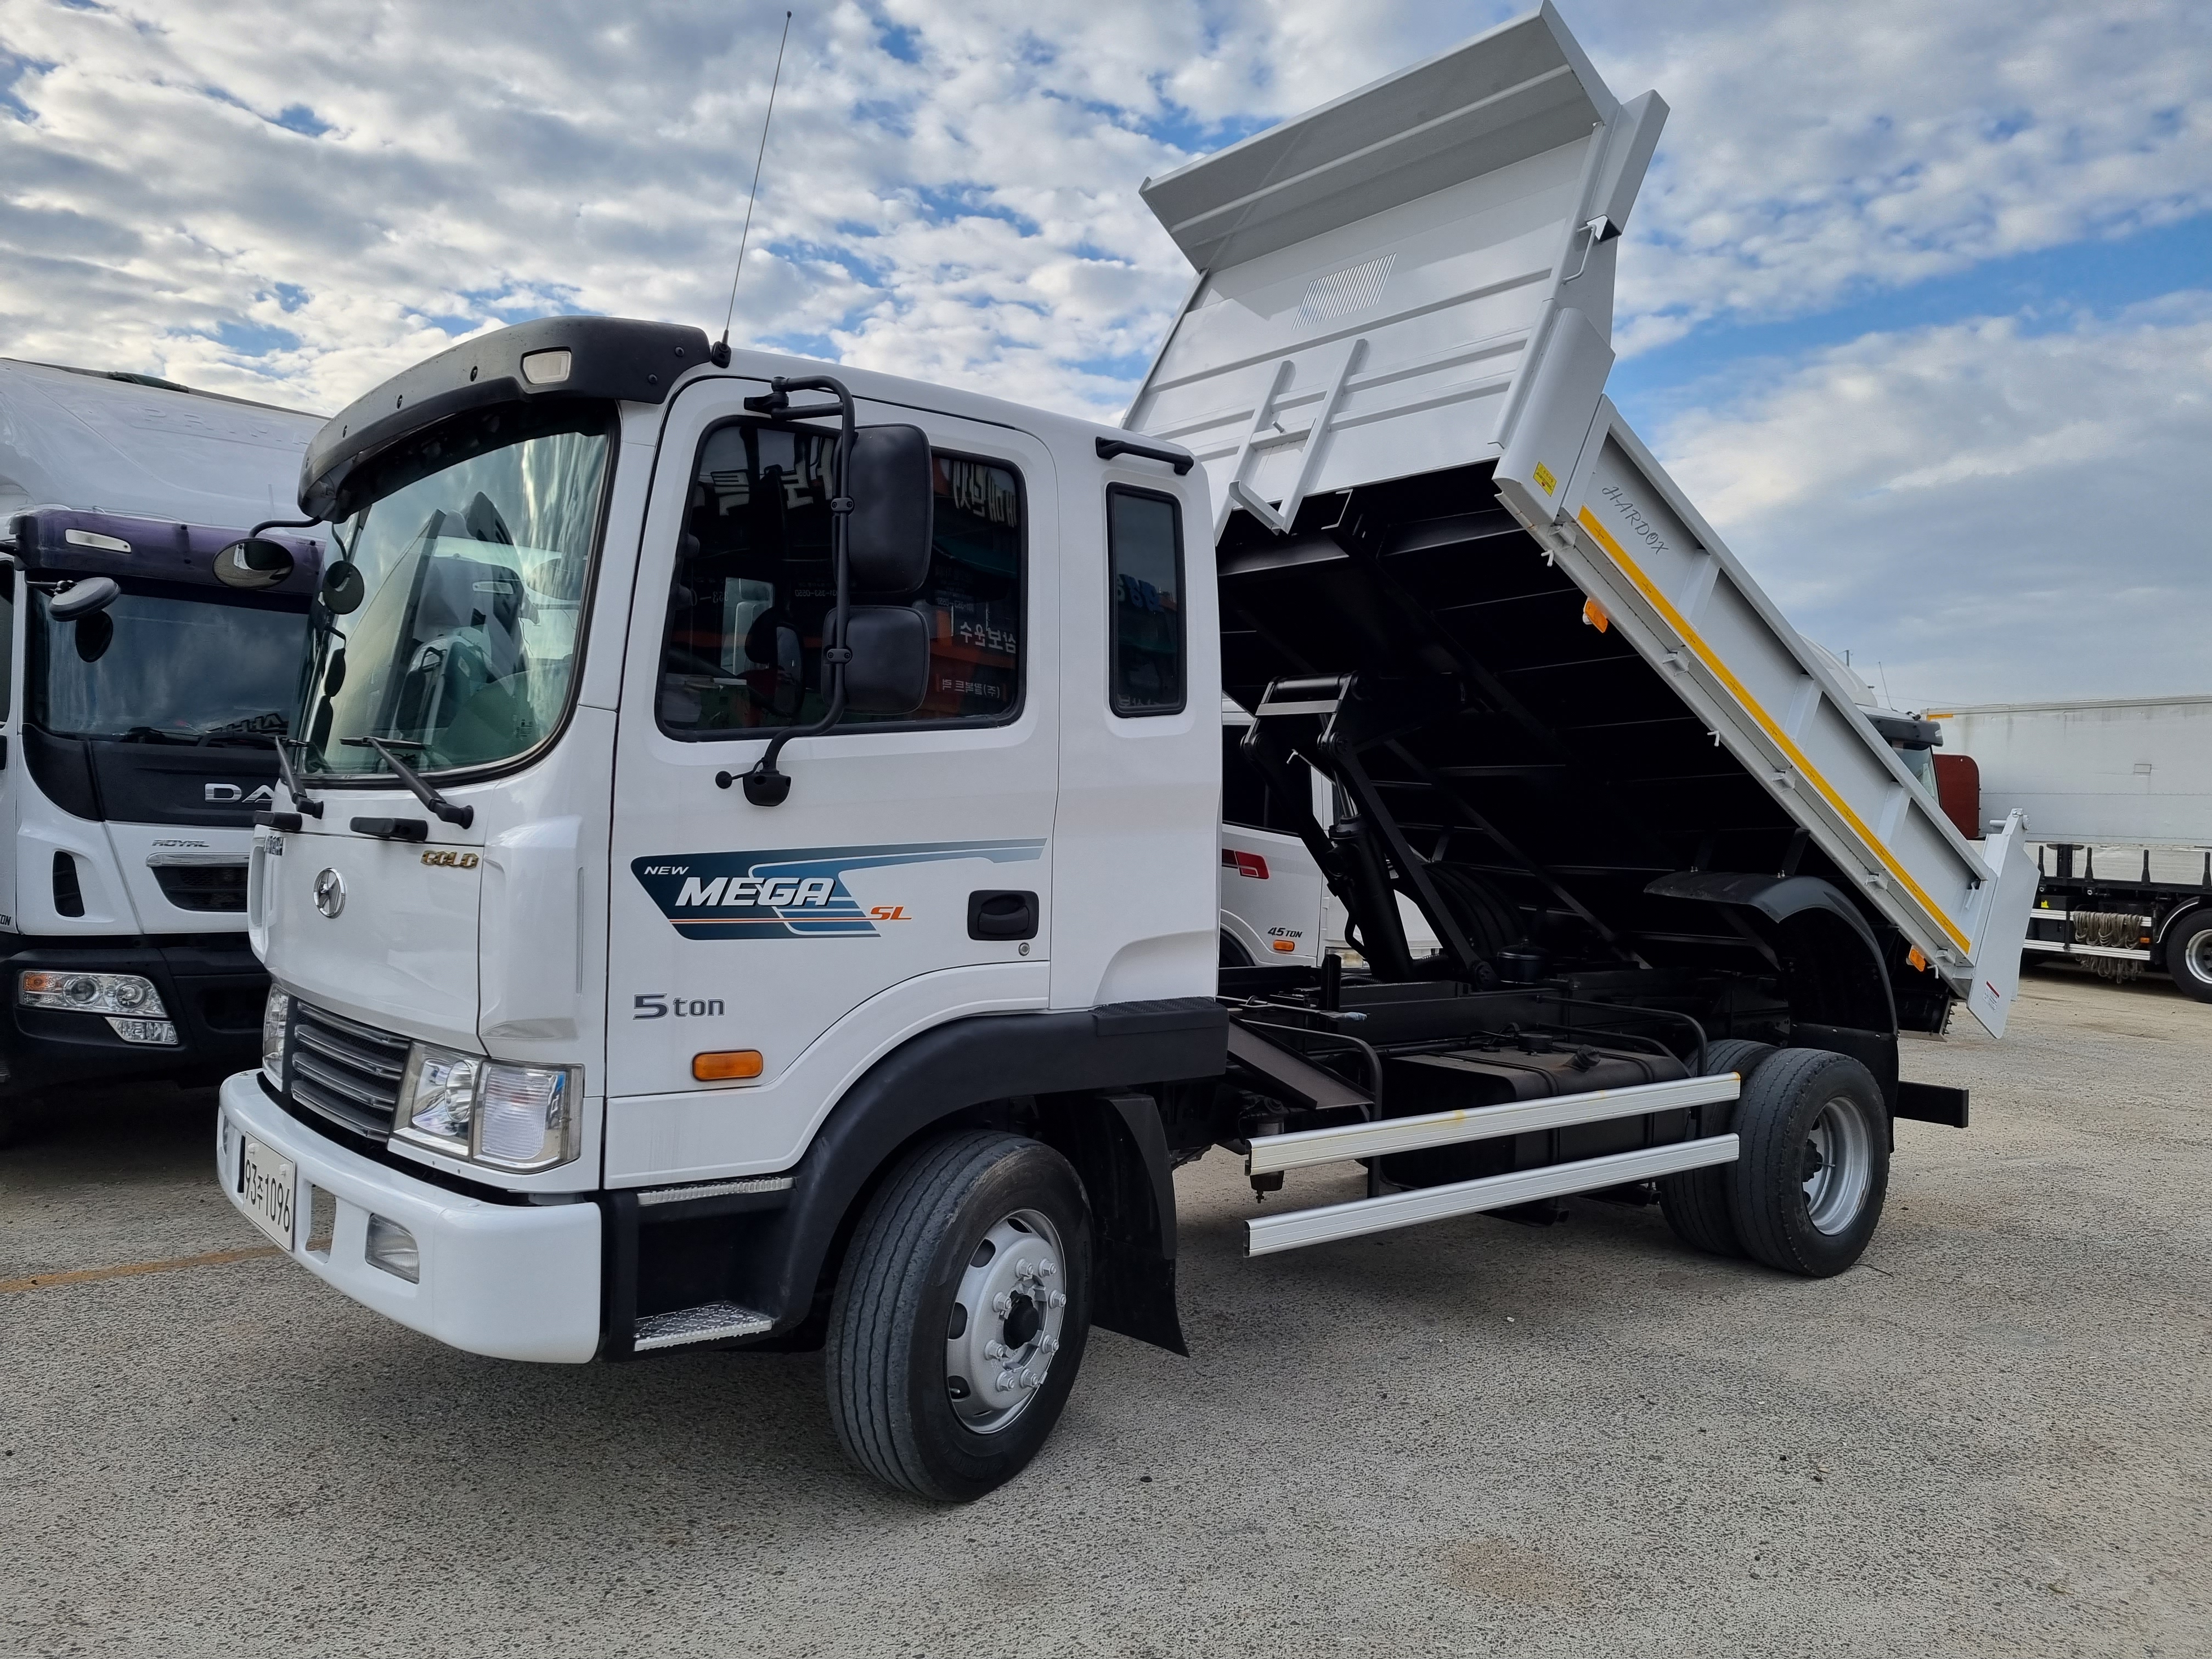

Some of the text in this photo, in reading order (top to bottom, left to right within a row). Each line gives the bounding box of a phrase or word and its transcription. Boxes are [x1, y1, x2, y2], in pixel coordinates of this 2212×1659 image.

[1602, 487, 1669, 555] HARDOX
[205, 783, 274, 803] DA
[152, 839, 210, 848] ROYAL
[420, 850, 479, 869] GOLD
[644, 866, 689, 875] NEW
[675, 877, 837, 907] MEGA
[0, 913, 12, 926] ON
[870, 906, 913, 921] SL
[633, 993, 725, 1020] 5 ton
